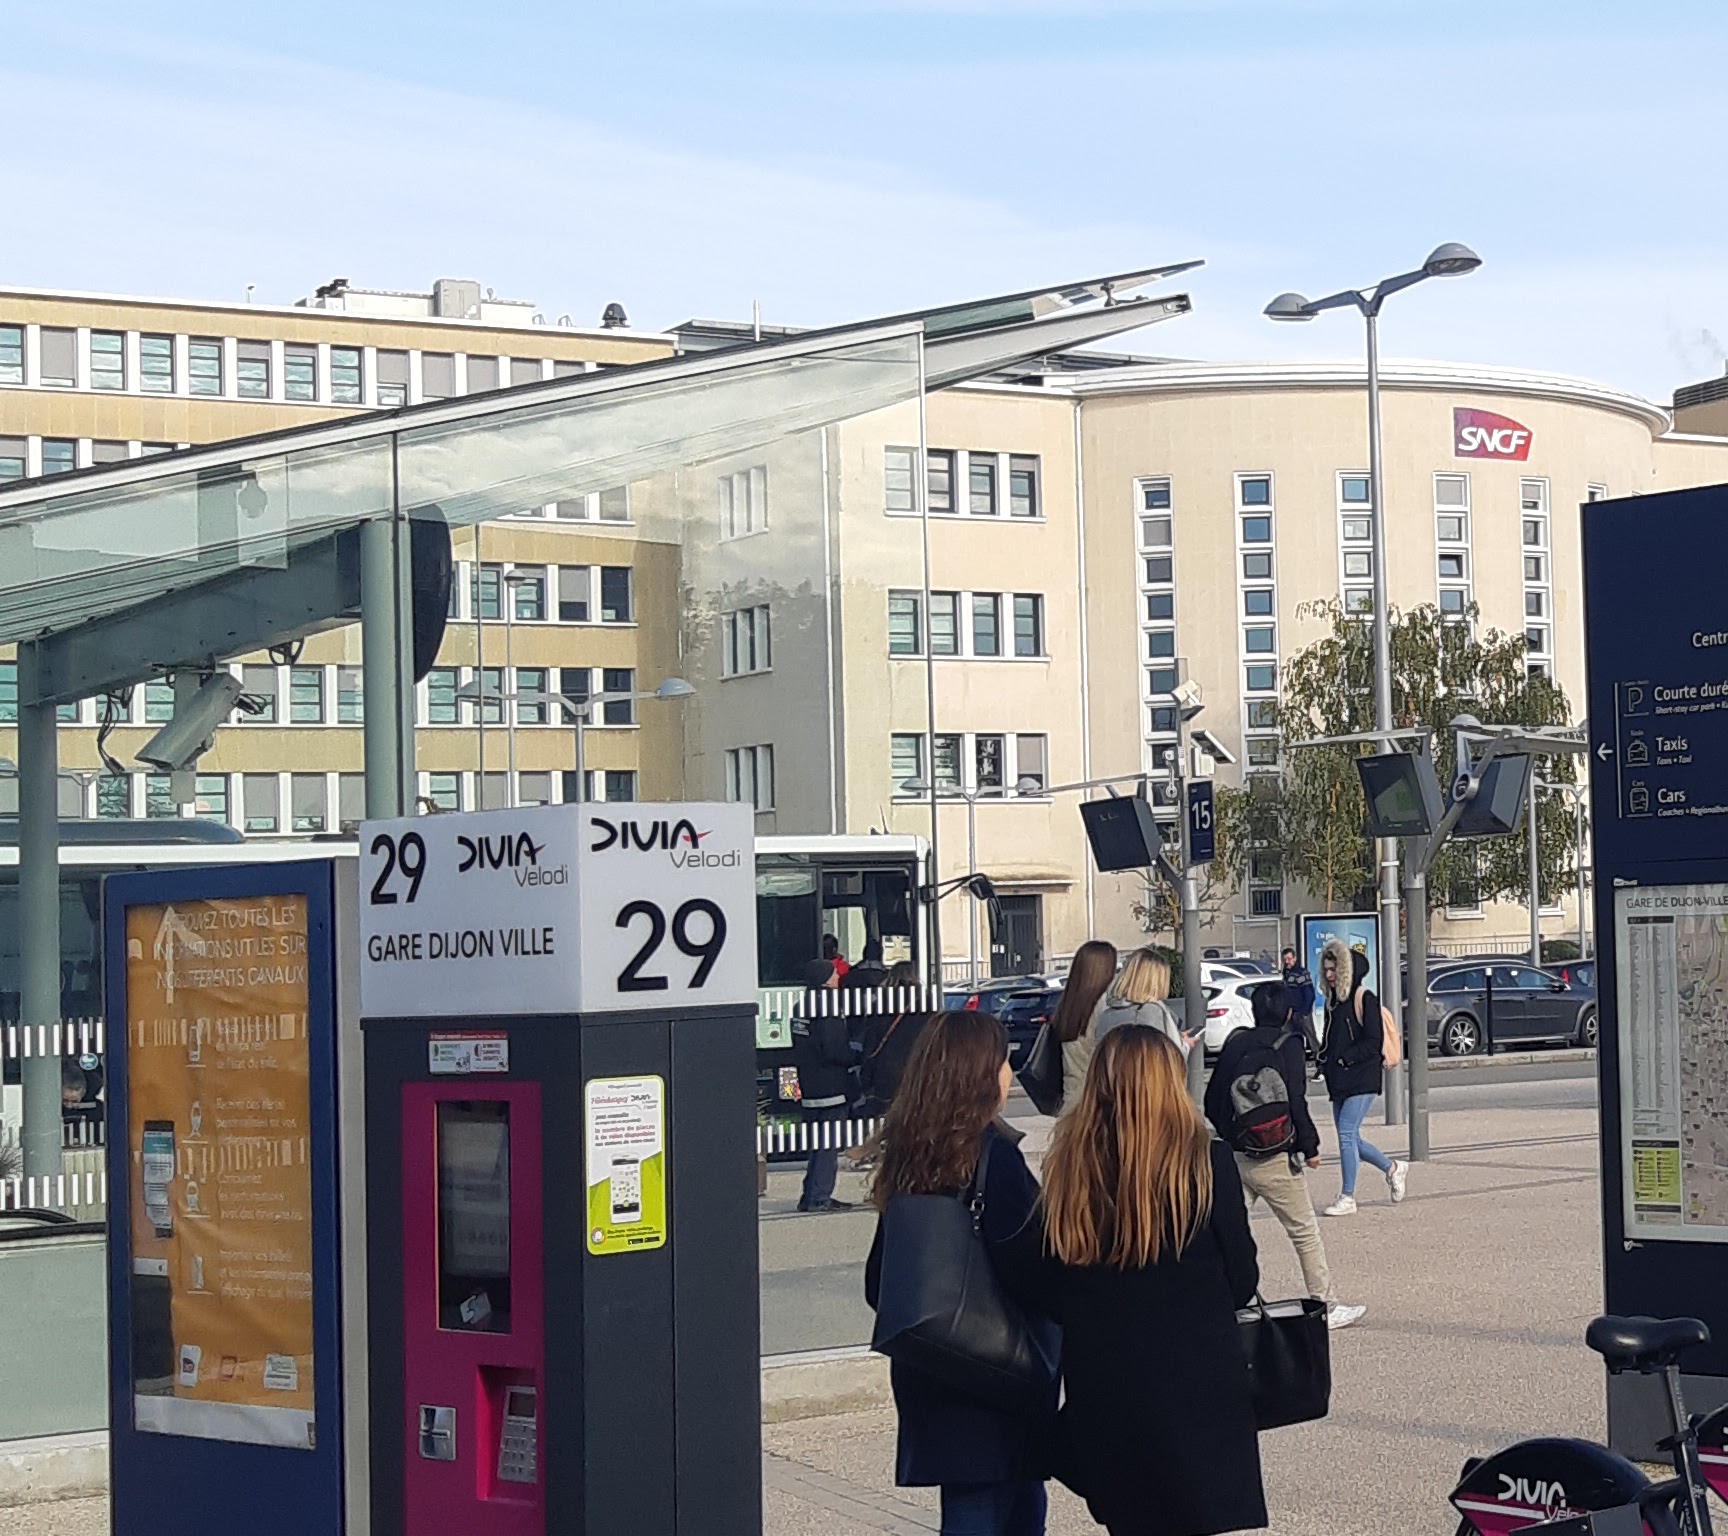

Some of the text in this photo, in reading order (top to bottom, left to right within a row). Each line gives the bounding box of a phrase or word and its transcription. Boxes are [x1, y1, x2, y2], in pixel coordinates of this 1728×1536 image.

[1458, 427, 1528, 453] SNCF
[1654, 684, 1697, 701] Courte
[1656, 736, 1688, 752] Taxis
[1658, 788, 1686, 803] Cars
[1192, 801, 1211, 829] 15
[591, 818, 710, 852] DIVIA
[457, 831, 543, 873] DIVIA
[670, 849, 741, 869] Velodi
[370, 831, 427, 905] 29
[514, 864, 569, 887] Velodi
[272, 904, 297, 925] LES
[1626, 897, 1652, 909] GARE
[1655, 897, 1668, 908] DE
[368, 927, 555, 962] GARE DIJON VILLE
[615, 898, 727, 992] 29
[248, 965, 305, 986] CANAUX
[1497, 1473, 1567, 1508] DIVIA
